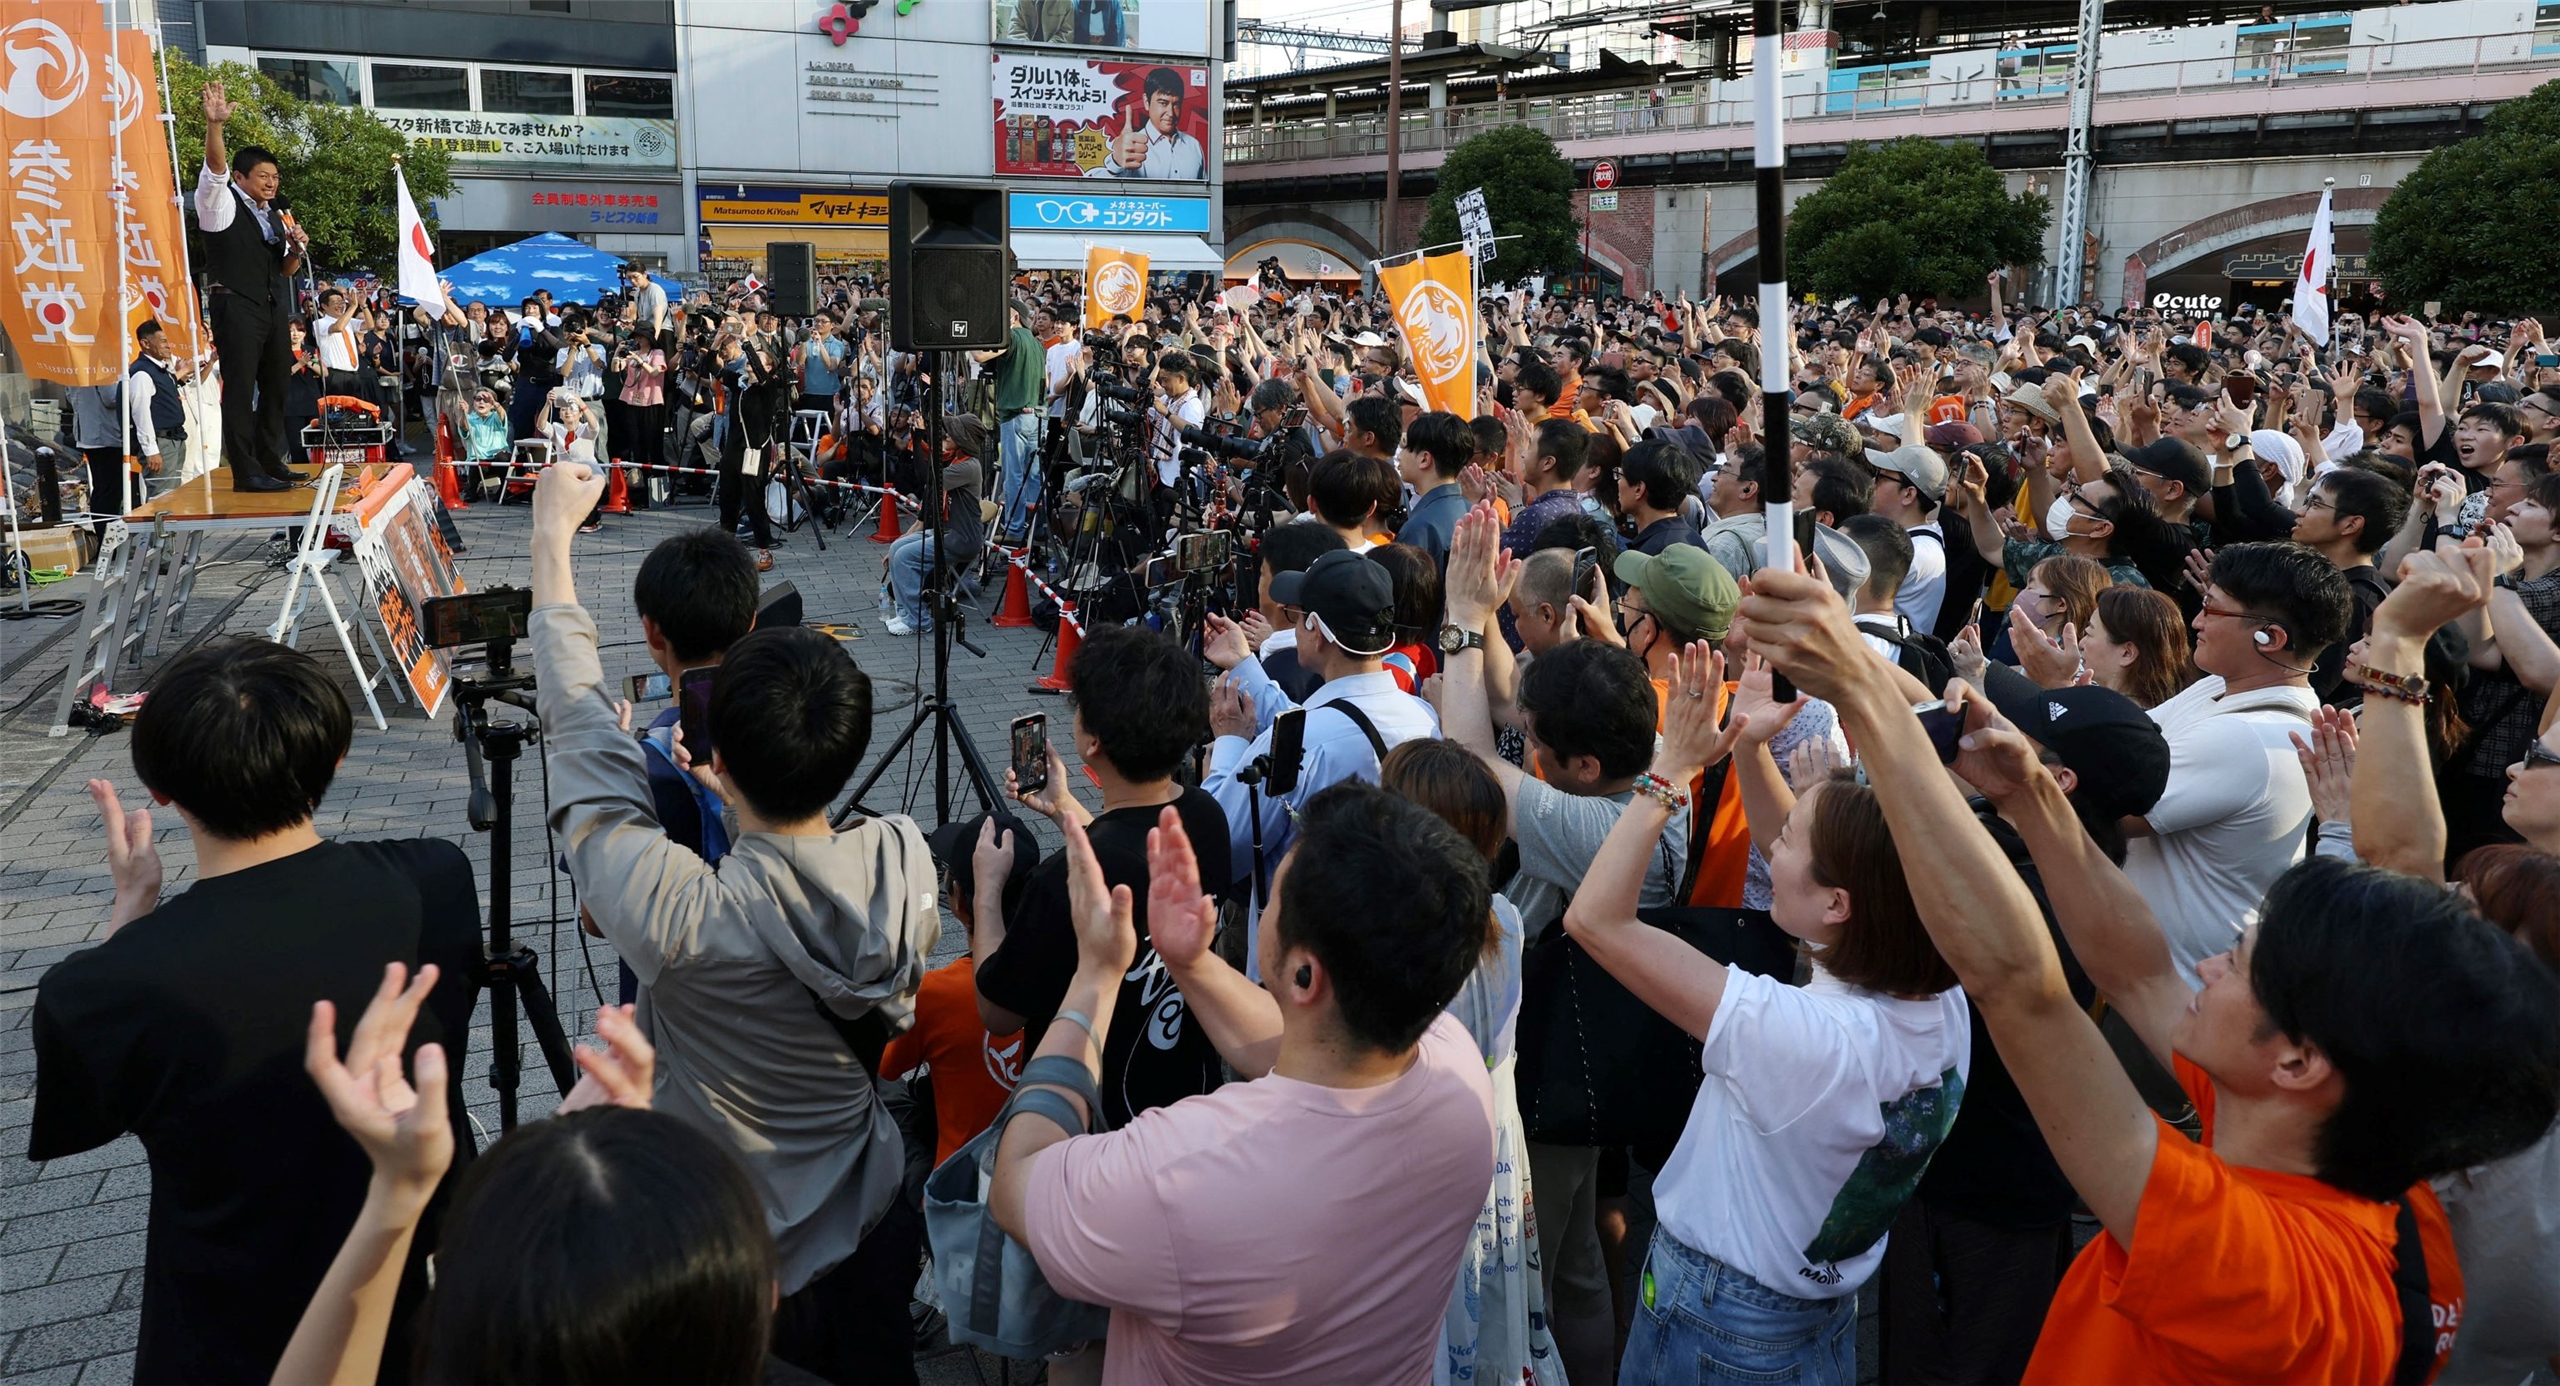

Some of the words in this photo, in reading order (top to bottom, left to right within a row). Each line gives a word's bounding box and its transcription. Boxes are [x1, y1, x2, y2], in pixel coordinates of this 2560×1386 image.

[1010, 65, 1091, 88] ダルい体に
[1010, 86, 1106, 104] スイッチ入れよう!
[2361, 175, 2371, 185] 17
[713, 207, 765, 215] Matsumoto
[767, 208, 799, 216] KiYoshi
[1109, 201, 1167, 210] メガネスーパー
[1103, 211, 1173, 227] コンタクト
[2153, 292, 2222, 309] ecute
